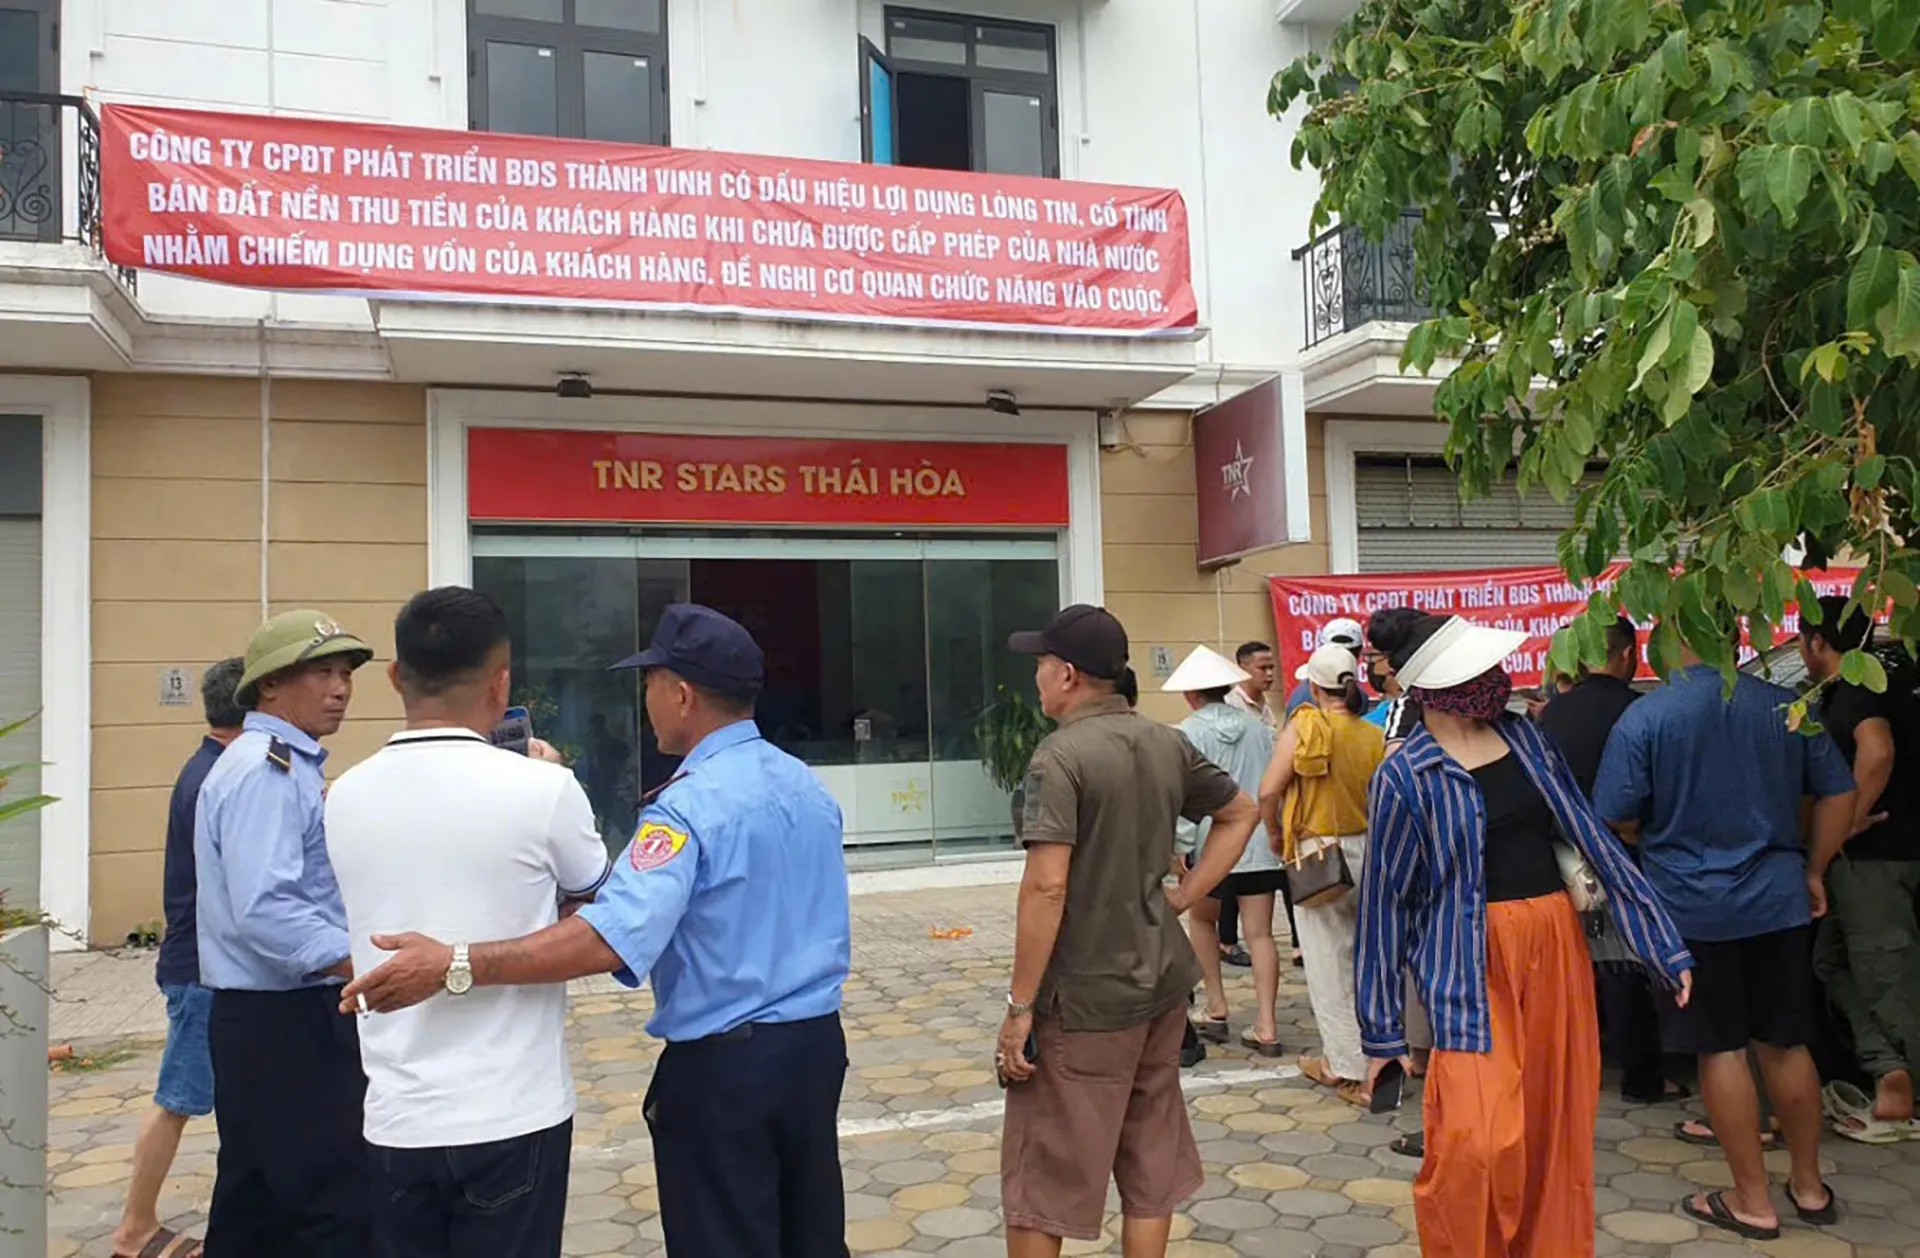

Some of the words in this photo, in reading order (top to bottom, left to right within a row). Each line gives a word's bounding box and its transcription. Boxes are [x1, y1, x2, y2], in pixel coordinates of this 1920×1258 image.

[129, 129, 211, 166] CÔNG
[220, 139, 253, 169] TY
[263, 142, 335, 175] CPĐT
[344, 145, 413, 179] PHÁT
[421, 145, 497, 185] TRIỂN
[506, 159, 557, 188] BĐS
[565, 159, 648, 193] THÀNH
[654, 168, 712, 197] VINH
[720, 169, 751, 201] CÓ
[759, 169, 806, 205] DẤU
[813, 176, 866, 214] HIỆU
[872, 184, 908, 216] LỢI
[914, 188, 976, 220] DỤNG
[982, 190, 1038, 222] LÒNG
[1089, 196, 1119, 228] CỐ
[1122, 203, 1168, 233] TÌNH
[148, 177, 209, 213] BÁN
[217, 179, 272, 217] ĐẤT
[281, 183, 340, 222] NỀN
[349, 196, 399, 225] THU
[408, 192, 466, 229] TIỀN
[475, 195, 529, 232] CỦA
[536, 198, 621, 235] KHÁCH
[629, 205, 697, 241] HÀNG
[705, 215, 744, 243] KHI
[752, 219, 817, 249] CHƯA
[822, 223, 885, 257] ĐƯỢC
[892, 220, 937, 256] CẤP
[943, 229, 1000, 260] PHÉP
[1008, 229, 1051, 264] CỦA
[1056, 237, 1099, 268] NHÀ
[1104, 244, 1160, 273] NƯỚC
[144, 224, 229, 265] NHẰM
[239, 230, 330, 266] CHIẾM
[339, 240, 413, 273] DỤNG
[422, 238, 476, 273] VỐN
[485, 239, 538, 276] CỦA
[546, 246, 631, 281] KHÁCH
[759, 263, 817, 299] NGHỊ
[823, 269, 854, 296] CƠ
[862, 270, 924, 299] QUAN
[930, 270, 990, 302] CHỨC
[996, 277, 1056, 307] NĂNG
[1062, 279, 1102, 310] VÀO
[593, 460, 664, 490] TNR
[676, 462, 787, 494] STARS
[799, 458, 879, 495] THÁI
[890, 459, 966, 496] HÒA
[1341, 593, 1360, 613] TY
[170, 676, 182, 690] 13
